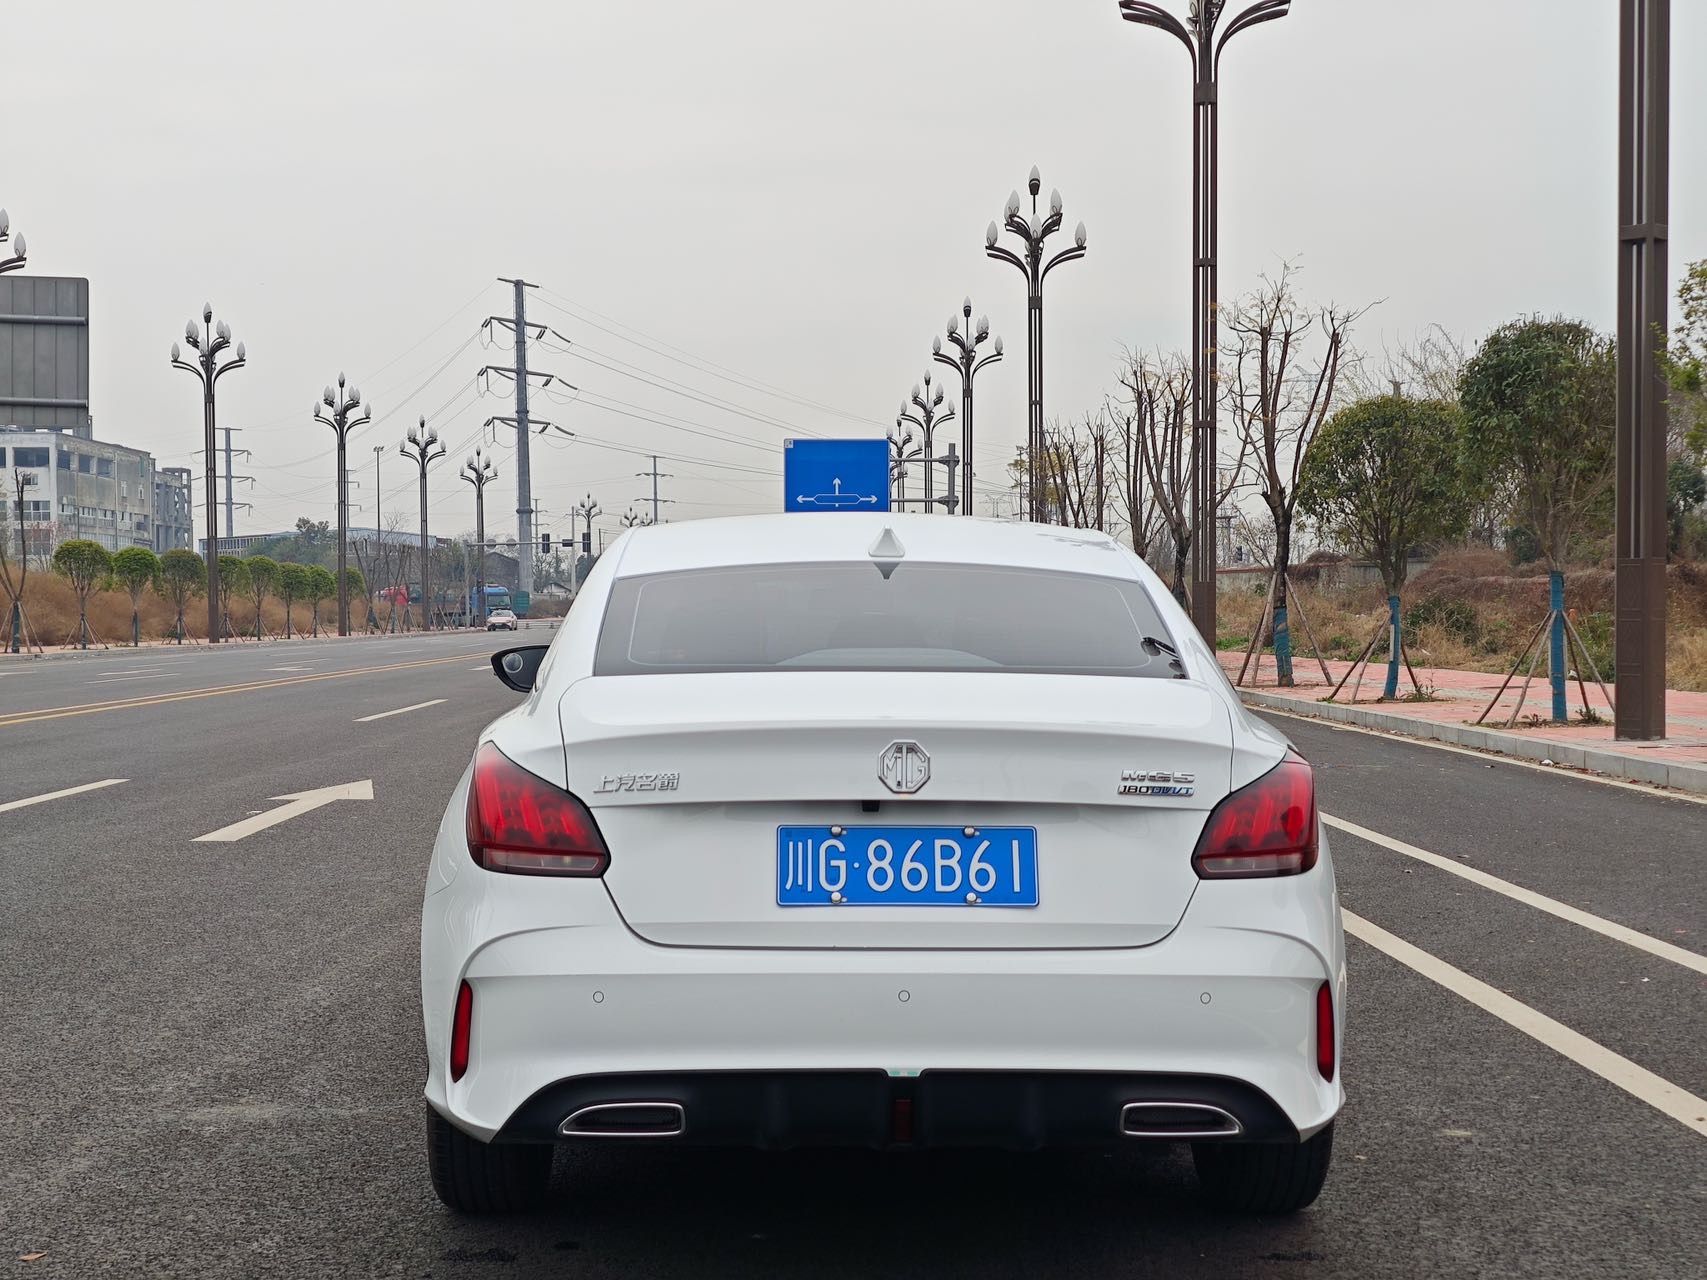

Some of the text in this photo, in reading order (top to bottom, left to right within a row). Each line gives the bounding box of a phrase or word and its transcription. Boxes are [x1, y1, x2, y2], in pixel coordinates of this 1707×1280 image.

[881, 743, 928, 790] MG
[1121, 769, 1195, 783] MG5
[593, 772, 680, 794] 上汽名爵
